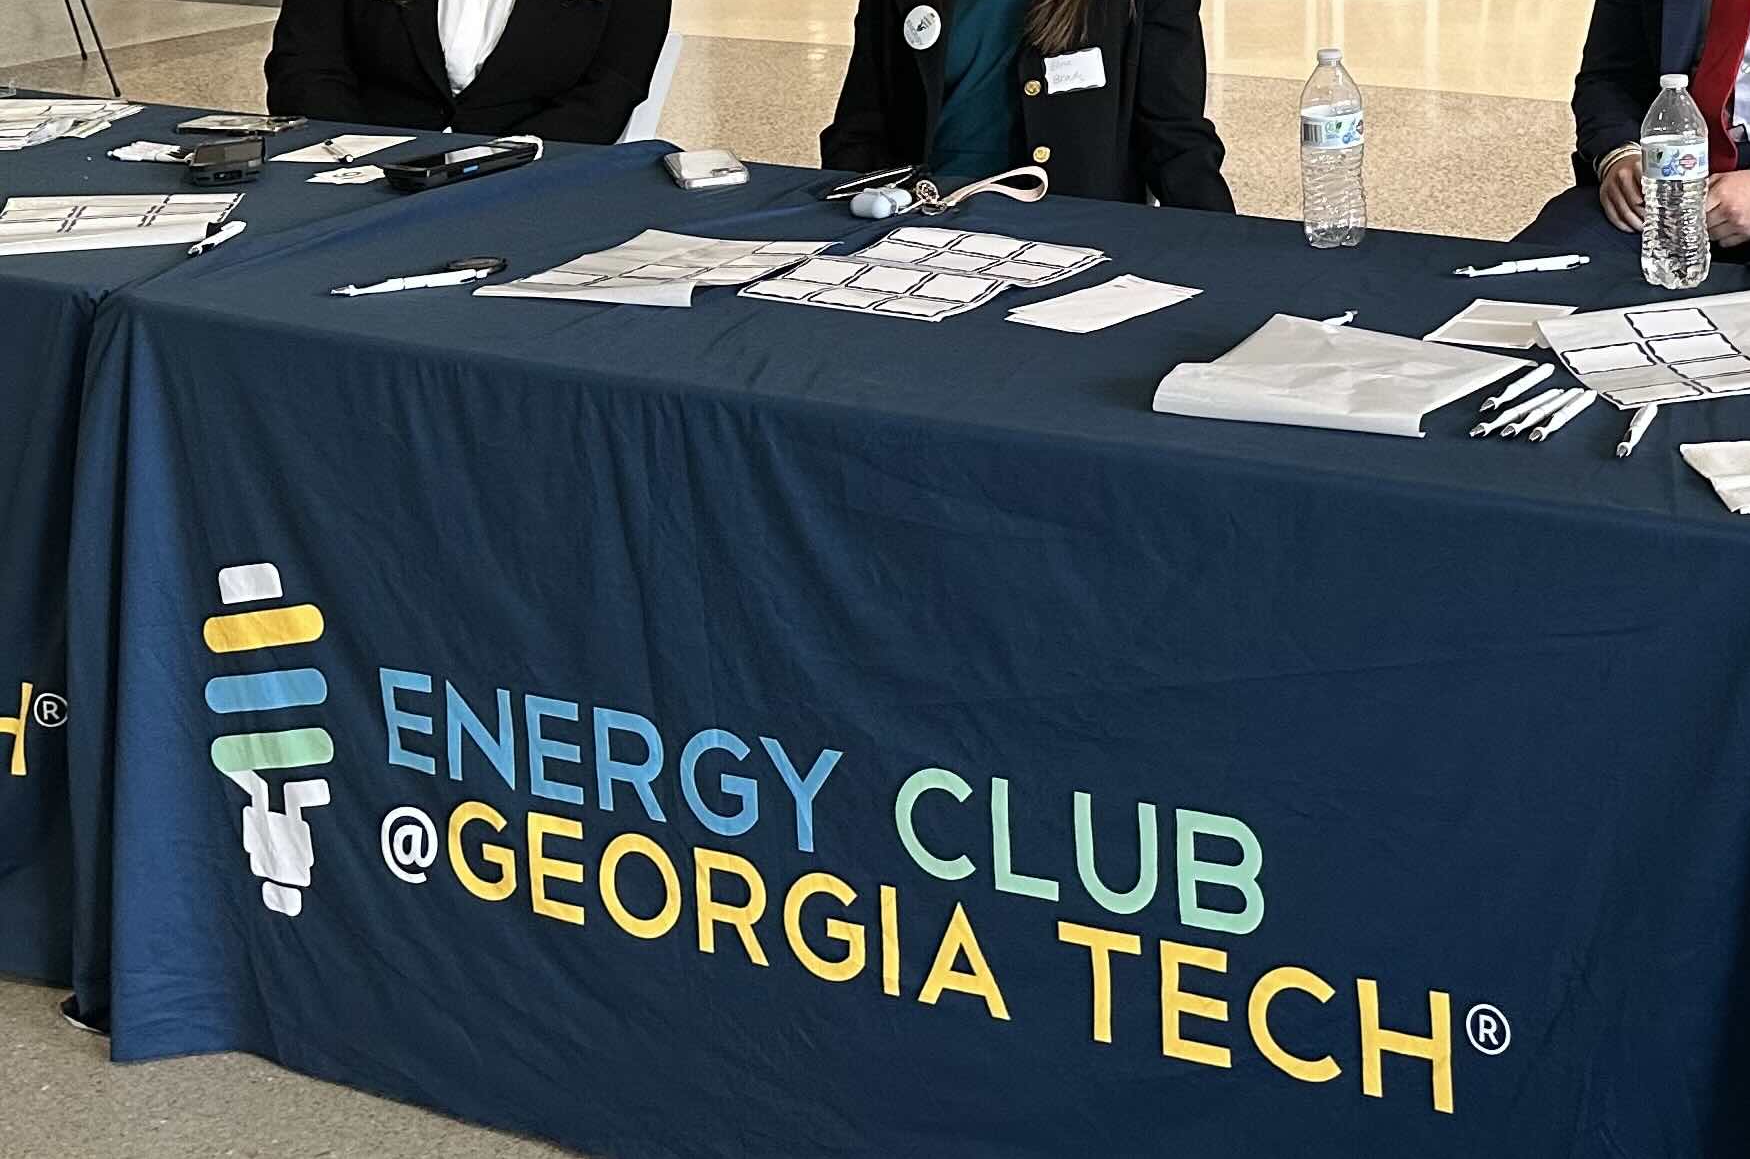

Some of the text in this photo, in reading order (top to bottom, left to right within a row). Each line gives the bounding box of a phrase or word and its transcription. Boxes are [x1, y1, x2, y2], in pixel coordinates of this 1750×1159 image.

[379, 667, 1265, 935] ENERGY CLUB
[381, 800, 1011, 1022] @GEORGIA
